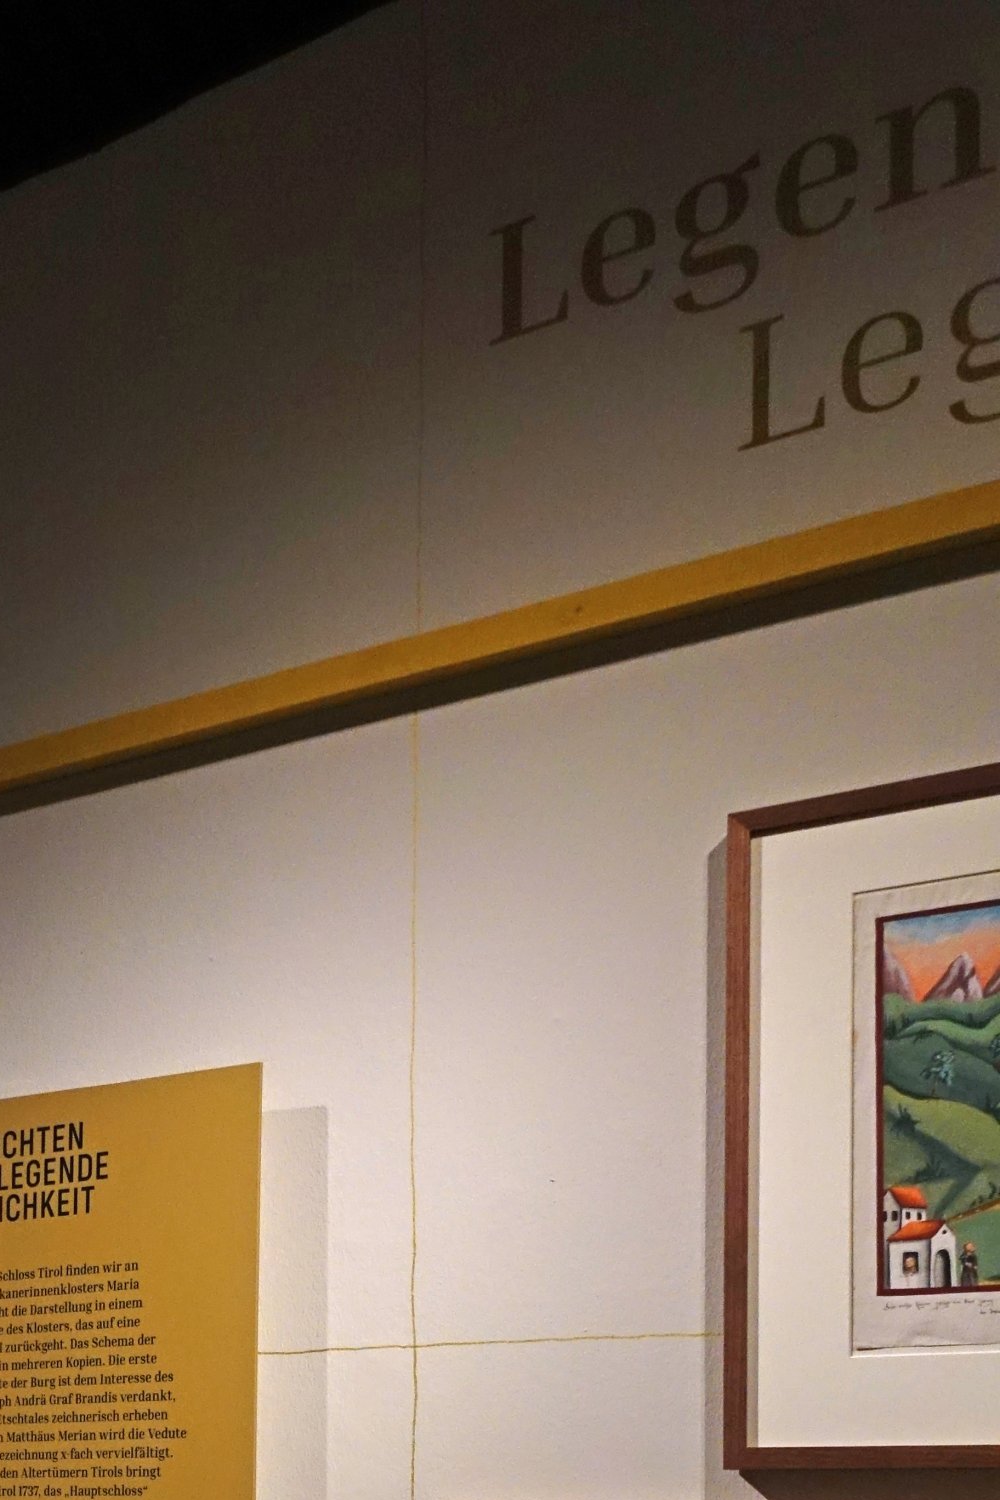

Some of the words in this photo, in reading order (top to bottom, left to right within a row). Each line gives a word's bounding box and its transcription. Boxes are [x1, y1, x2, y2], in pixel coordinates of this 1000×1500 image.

[489, 86, 998, 346] Legen
[37, 1264, 64, 1279] Tirol
[65, 1261, 101, 1277] finden
[101, 1260, 123, 1274] wir
[123, 1261, 139, 1273] an
[106, 1277, 140, 1293] Maria
[5, 1322, 24, 1336] des
[26, 1321, 73, 1335] Klosters,
[74, 1318, 94, 1331] das
[95, 1316, 116, 1330] auf
[116, 1315, 141, 1329] eine
[10, 1357, 63, 1371] mehreren
[65, 1354, 106, 1371] Kopien.
[108, 1353, 126, 1367] Die
[128, 1353, 158, 1365] erste
[13, 1393, 47, 1407] Andrä
[48, 1392, 75, 1406] Graf
[74, 1391, 118, 1405] Brandis
[119, 1388, 176, 1403] verdankt,
[5, 1430, 56, 1443] Matthäus
[57, 1429, 97, 1442] Merian
[98, 1427, 126, 1441] wird
[127, 1427, 146, 1441] die
[147, 1426, 188, 1440] Vedute
[95, 1445, 174, 1462] vervielfältigt.
[0, 1466, 19, 1480] den
[20, 1466, 89, 1479] Altertümern
[90, 1465, 124, 1479] Tirols
[125, 1464, 162, 1481] bringt
[18, 1485, 42, 1499] 1737,
[43, 1484, 62, 1497] das
